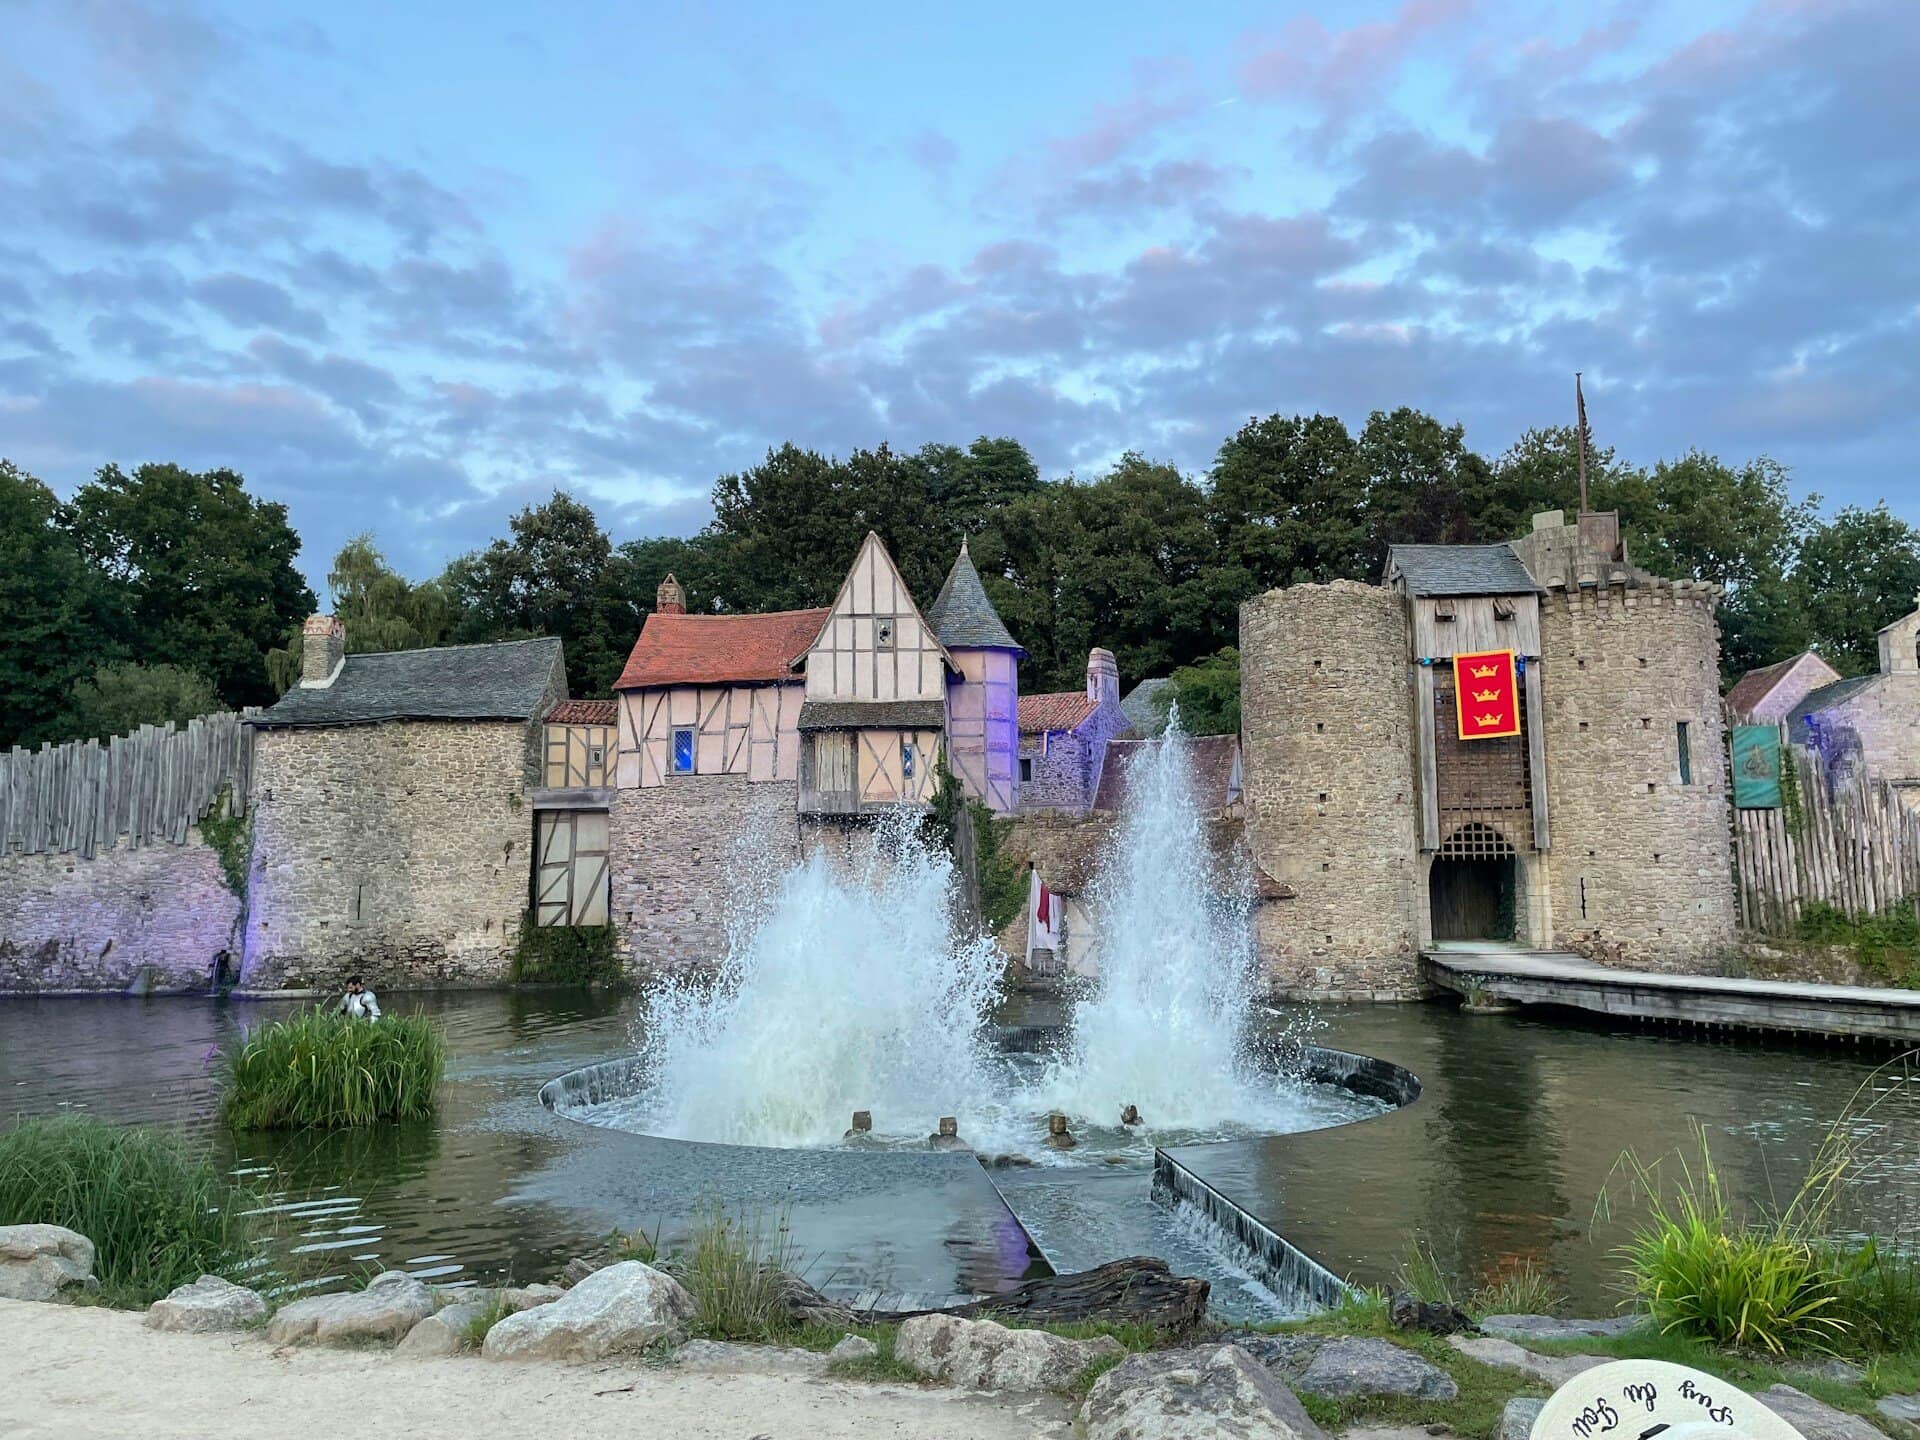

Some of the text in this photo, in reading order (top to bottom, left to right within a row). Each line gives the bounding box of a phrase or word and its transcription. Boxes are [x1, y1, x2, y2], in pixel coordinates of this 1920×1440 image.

[1572, 1380, 1734, 1438] Puy du Fou
